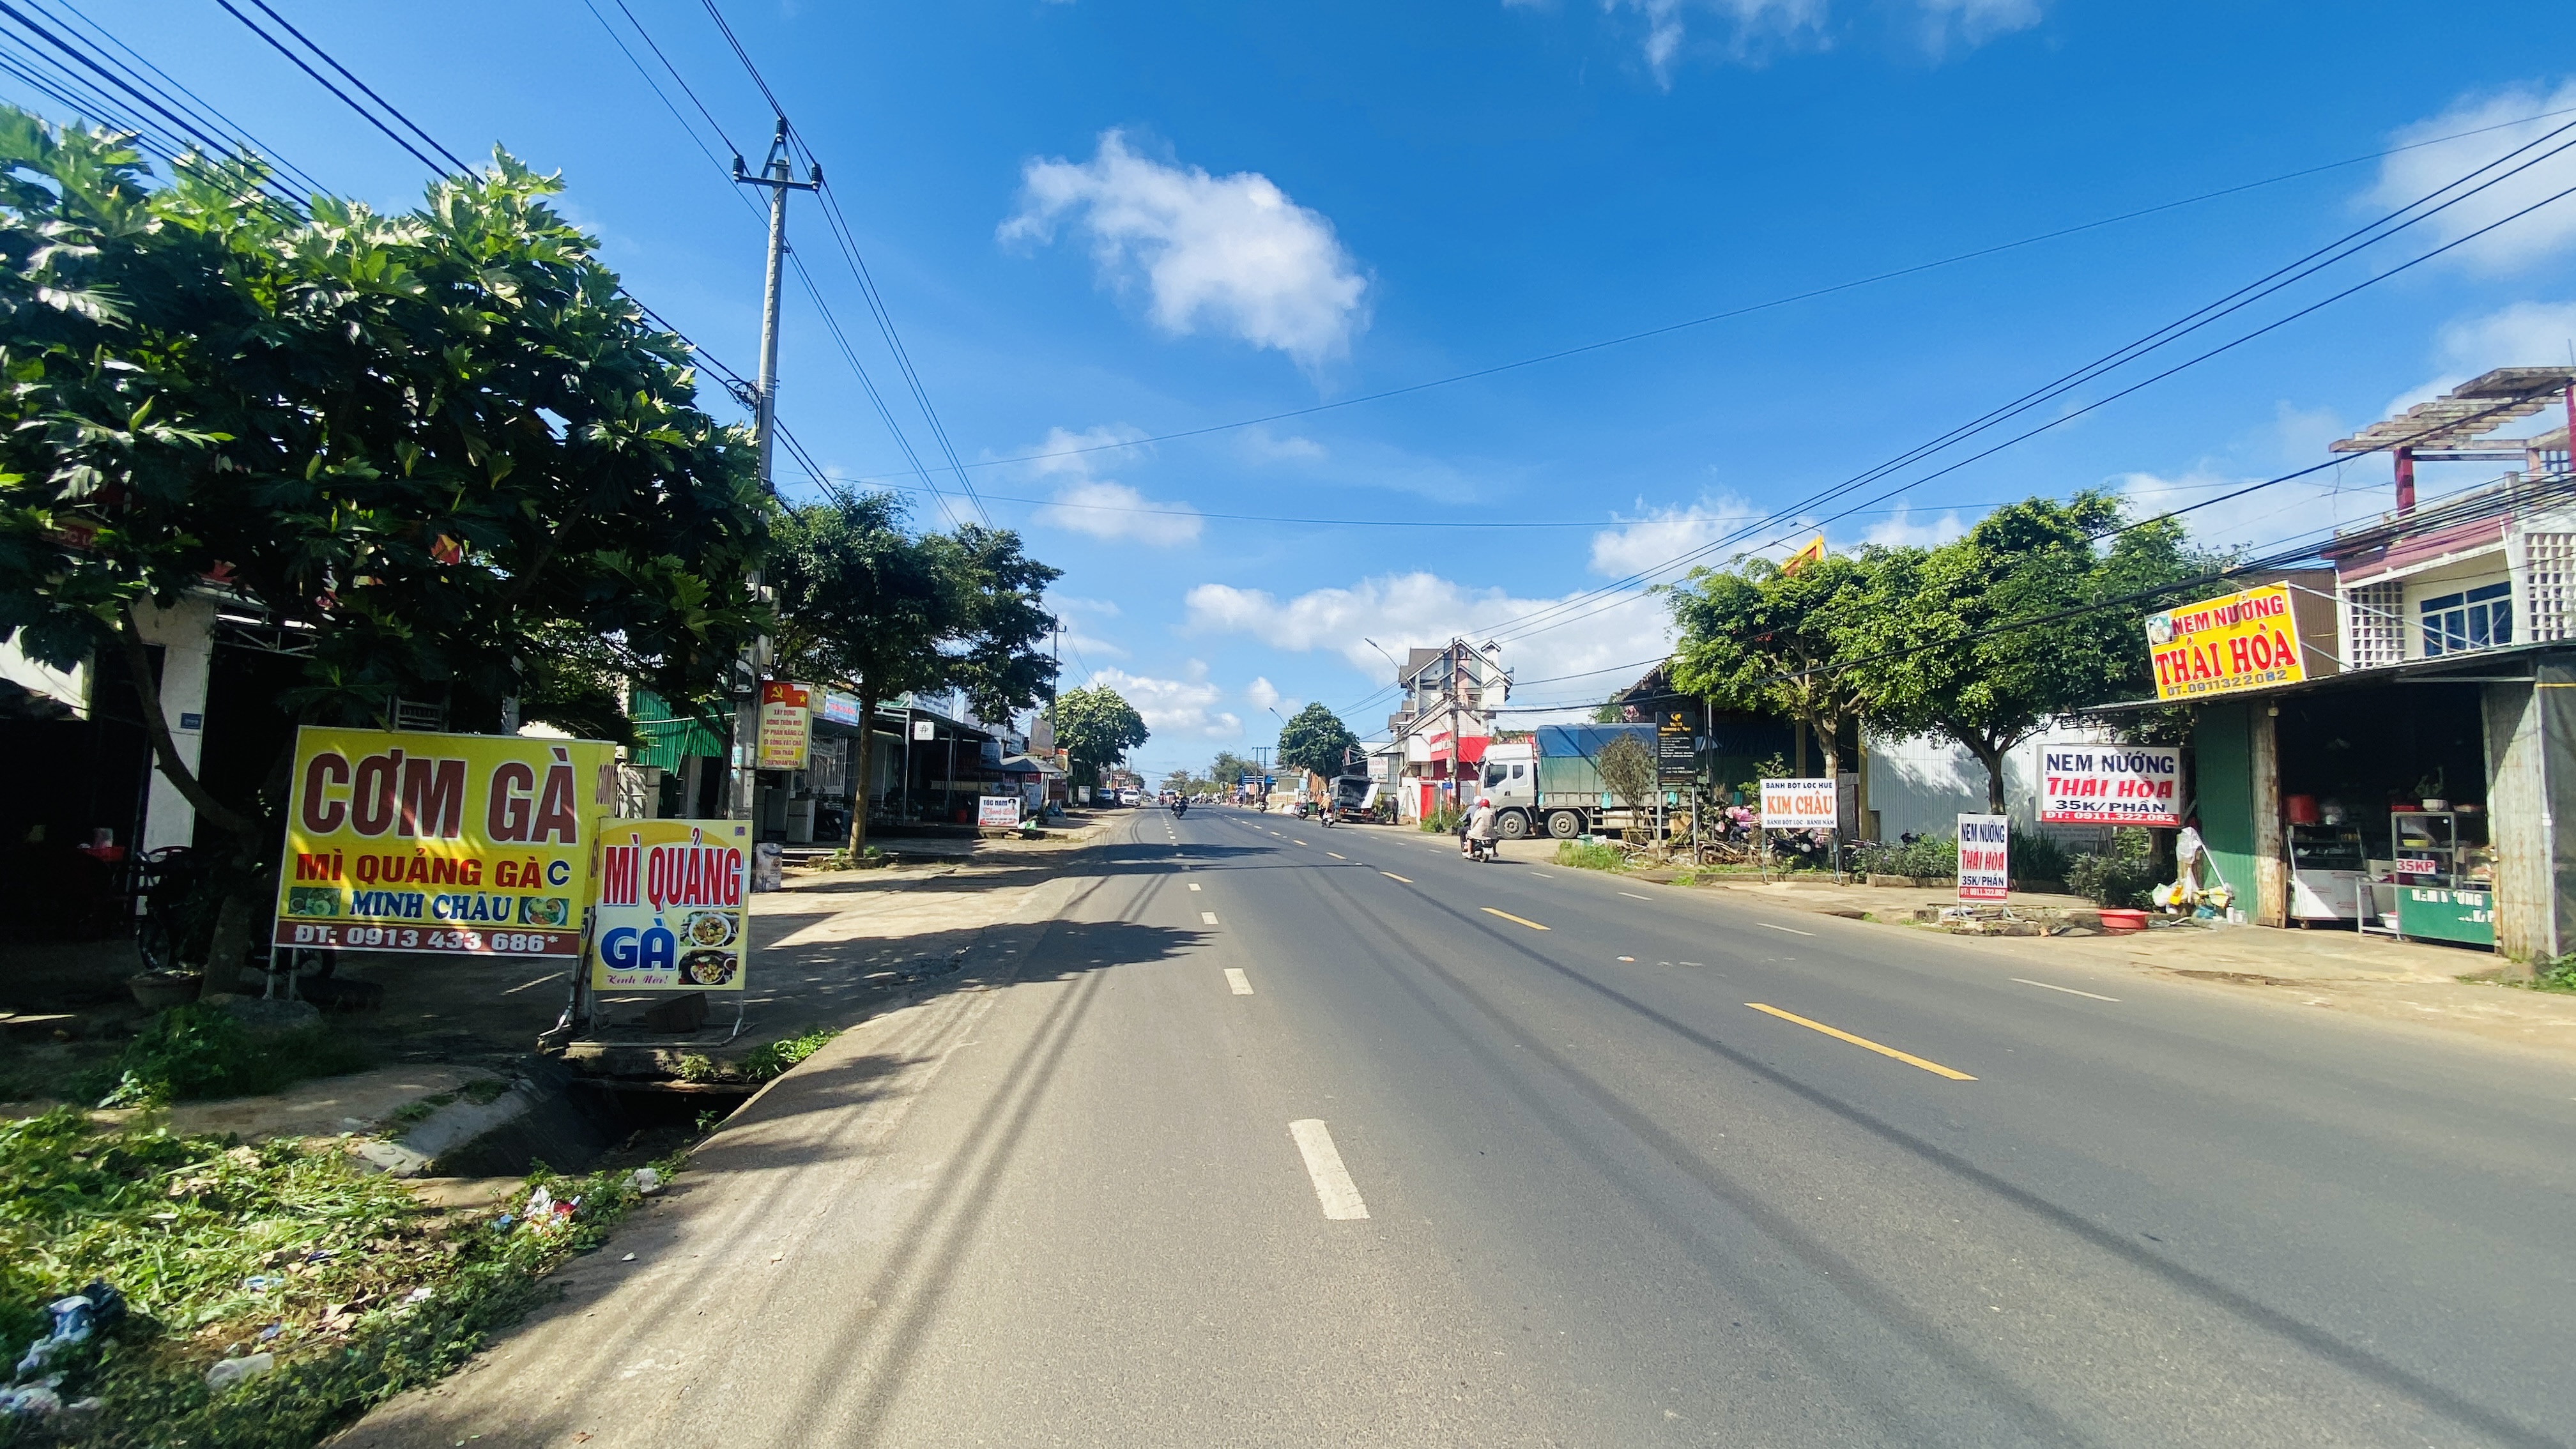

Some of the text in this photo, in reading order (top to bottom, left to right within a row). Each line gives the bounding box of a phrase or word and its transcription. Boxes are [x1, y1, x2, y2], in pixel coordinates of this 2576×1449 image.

[2172, 595, 2283, 636] NEM NƯỚNG
[2155, 623, 2296, 686] THÁI HÒA
[2047, 751, 2174, 774] NEM NƯỚNG
[303, 747, 577, 843] CƠM GÀ
[2048, 775, 2174, 799] THÁI HÒA
[1767, 790, 1832, 815] KIM CHÂU
[2074, 812, 2175, 822] 0911.322.082
[1961, 819, 2005, 843] NEM NƯỚNG
[296, 848, 343, 881] MÌ
[356, 848, 482, 885] QUẢNG
[494, 856, 543, 889] GÀ
[603, 834, 640, 905] MÌ
[648, 827, 741, 912] QUẢNG
[1962, 847, 2004, 871] THÁI HÒA
[2397, 860, 2434, 872] 35KP
[349, 890, 512, 921] MINH CHÂU
[295, 924, 337, 944] ĐT:
[347, 926, 420, 947] 0913
[427, 931, 482, 951] 433
[601, 918, 675, 970] GÀ
